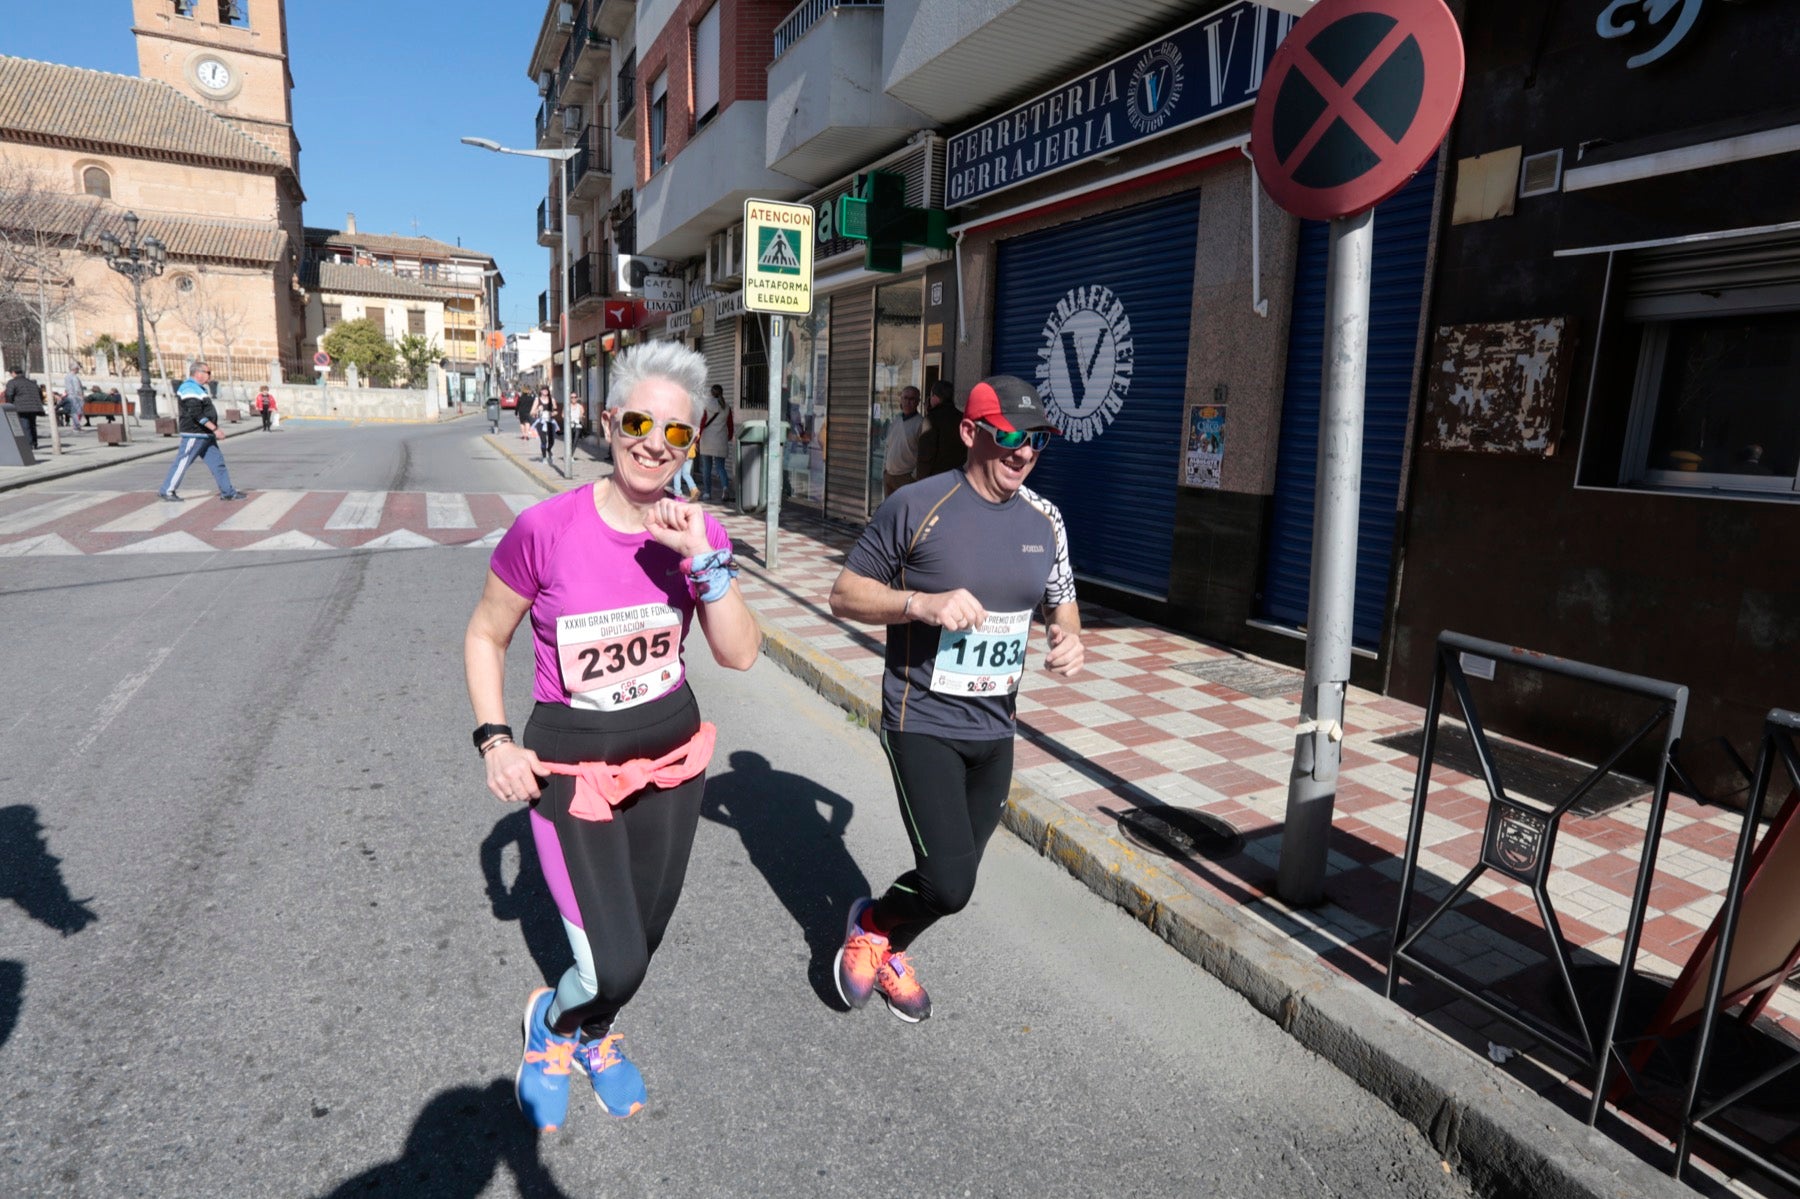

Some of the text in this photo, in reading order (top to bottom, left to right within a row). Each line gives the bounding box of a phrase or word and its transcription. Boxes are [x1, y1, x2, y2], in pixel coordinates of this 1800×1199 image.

[951, 68, 1120, 168] FERRETERIA
[951, 111, 1115, 200] CERRAJERIA
[750, 207, 811, 226] ATENCION
[662, 290, 683, 300] BAR
[748, 278, 809, 292] PLATAFORMA
[757, 293, 799, 305] ELEVADA
[564, 618, 587, 630] XXXIII
[588, 614, 609, 627] GRAN
[611, 609, 639, 622] PREMIO
[641, 607, 650, 619] DE
[988, 615, 1009, 625] PREMIO
[578, 631, 671, 682] 2305
[951, 638, 1021, 668] 1183
